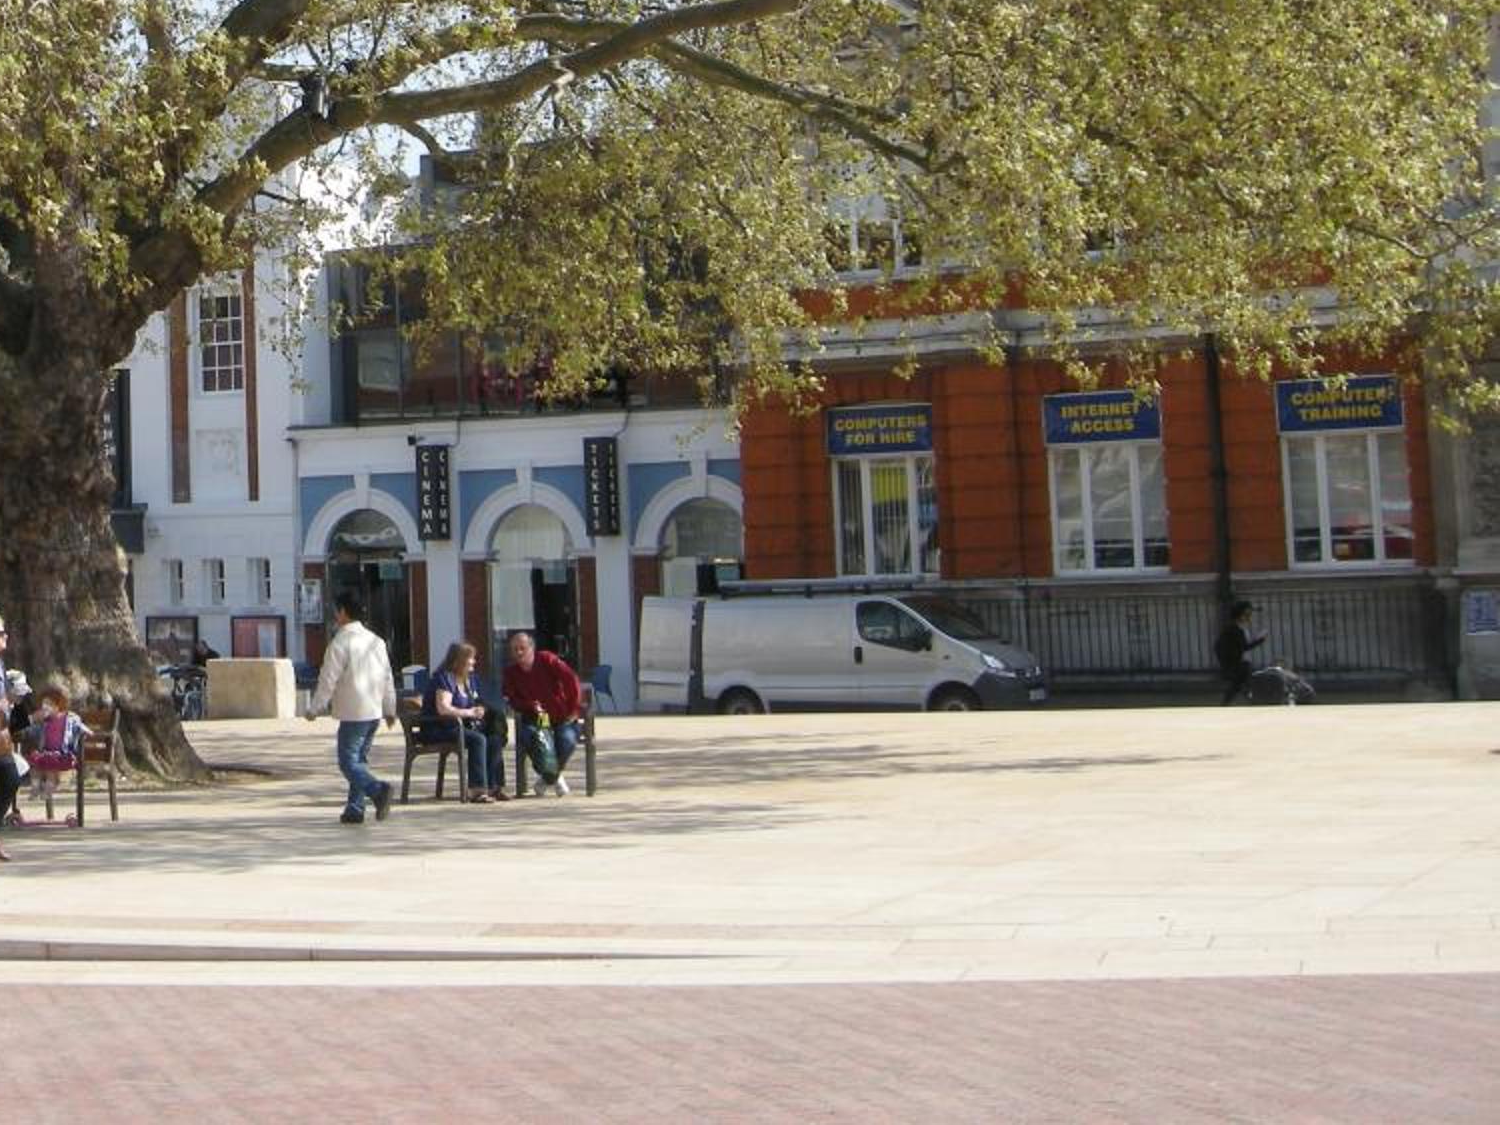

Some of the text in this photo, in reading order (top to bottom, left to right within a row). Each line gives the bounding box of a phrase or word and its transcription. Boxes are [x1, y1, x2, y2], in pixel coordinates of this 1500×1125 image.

[1061, 401, 1140, 418] INTERNET
[1300, 405, 1382, 422] TRAINING
[835, 415, 927, 432] COMPUTERS
[1070, 419, 1135, 434] ACCESS
[845, 430, 917, 445] FOR HIRE
[421, 451, 433, 534] CINEMA
